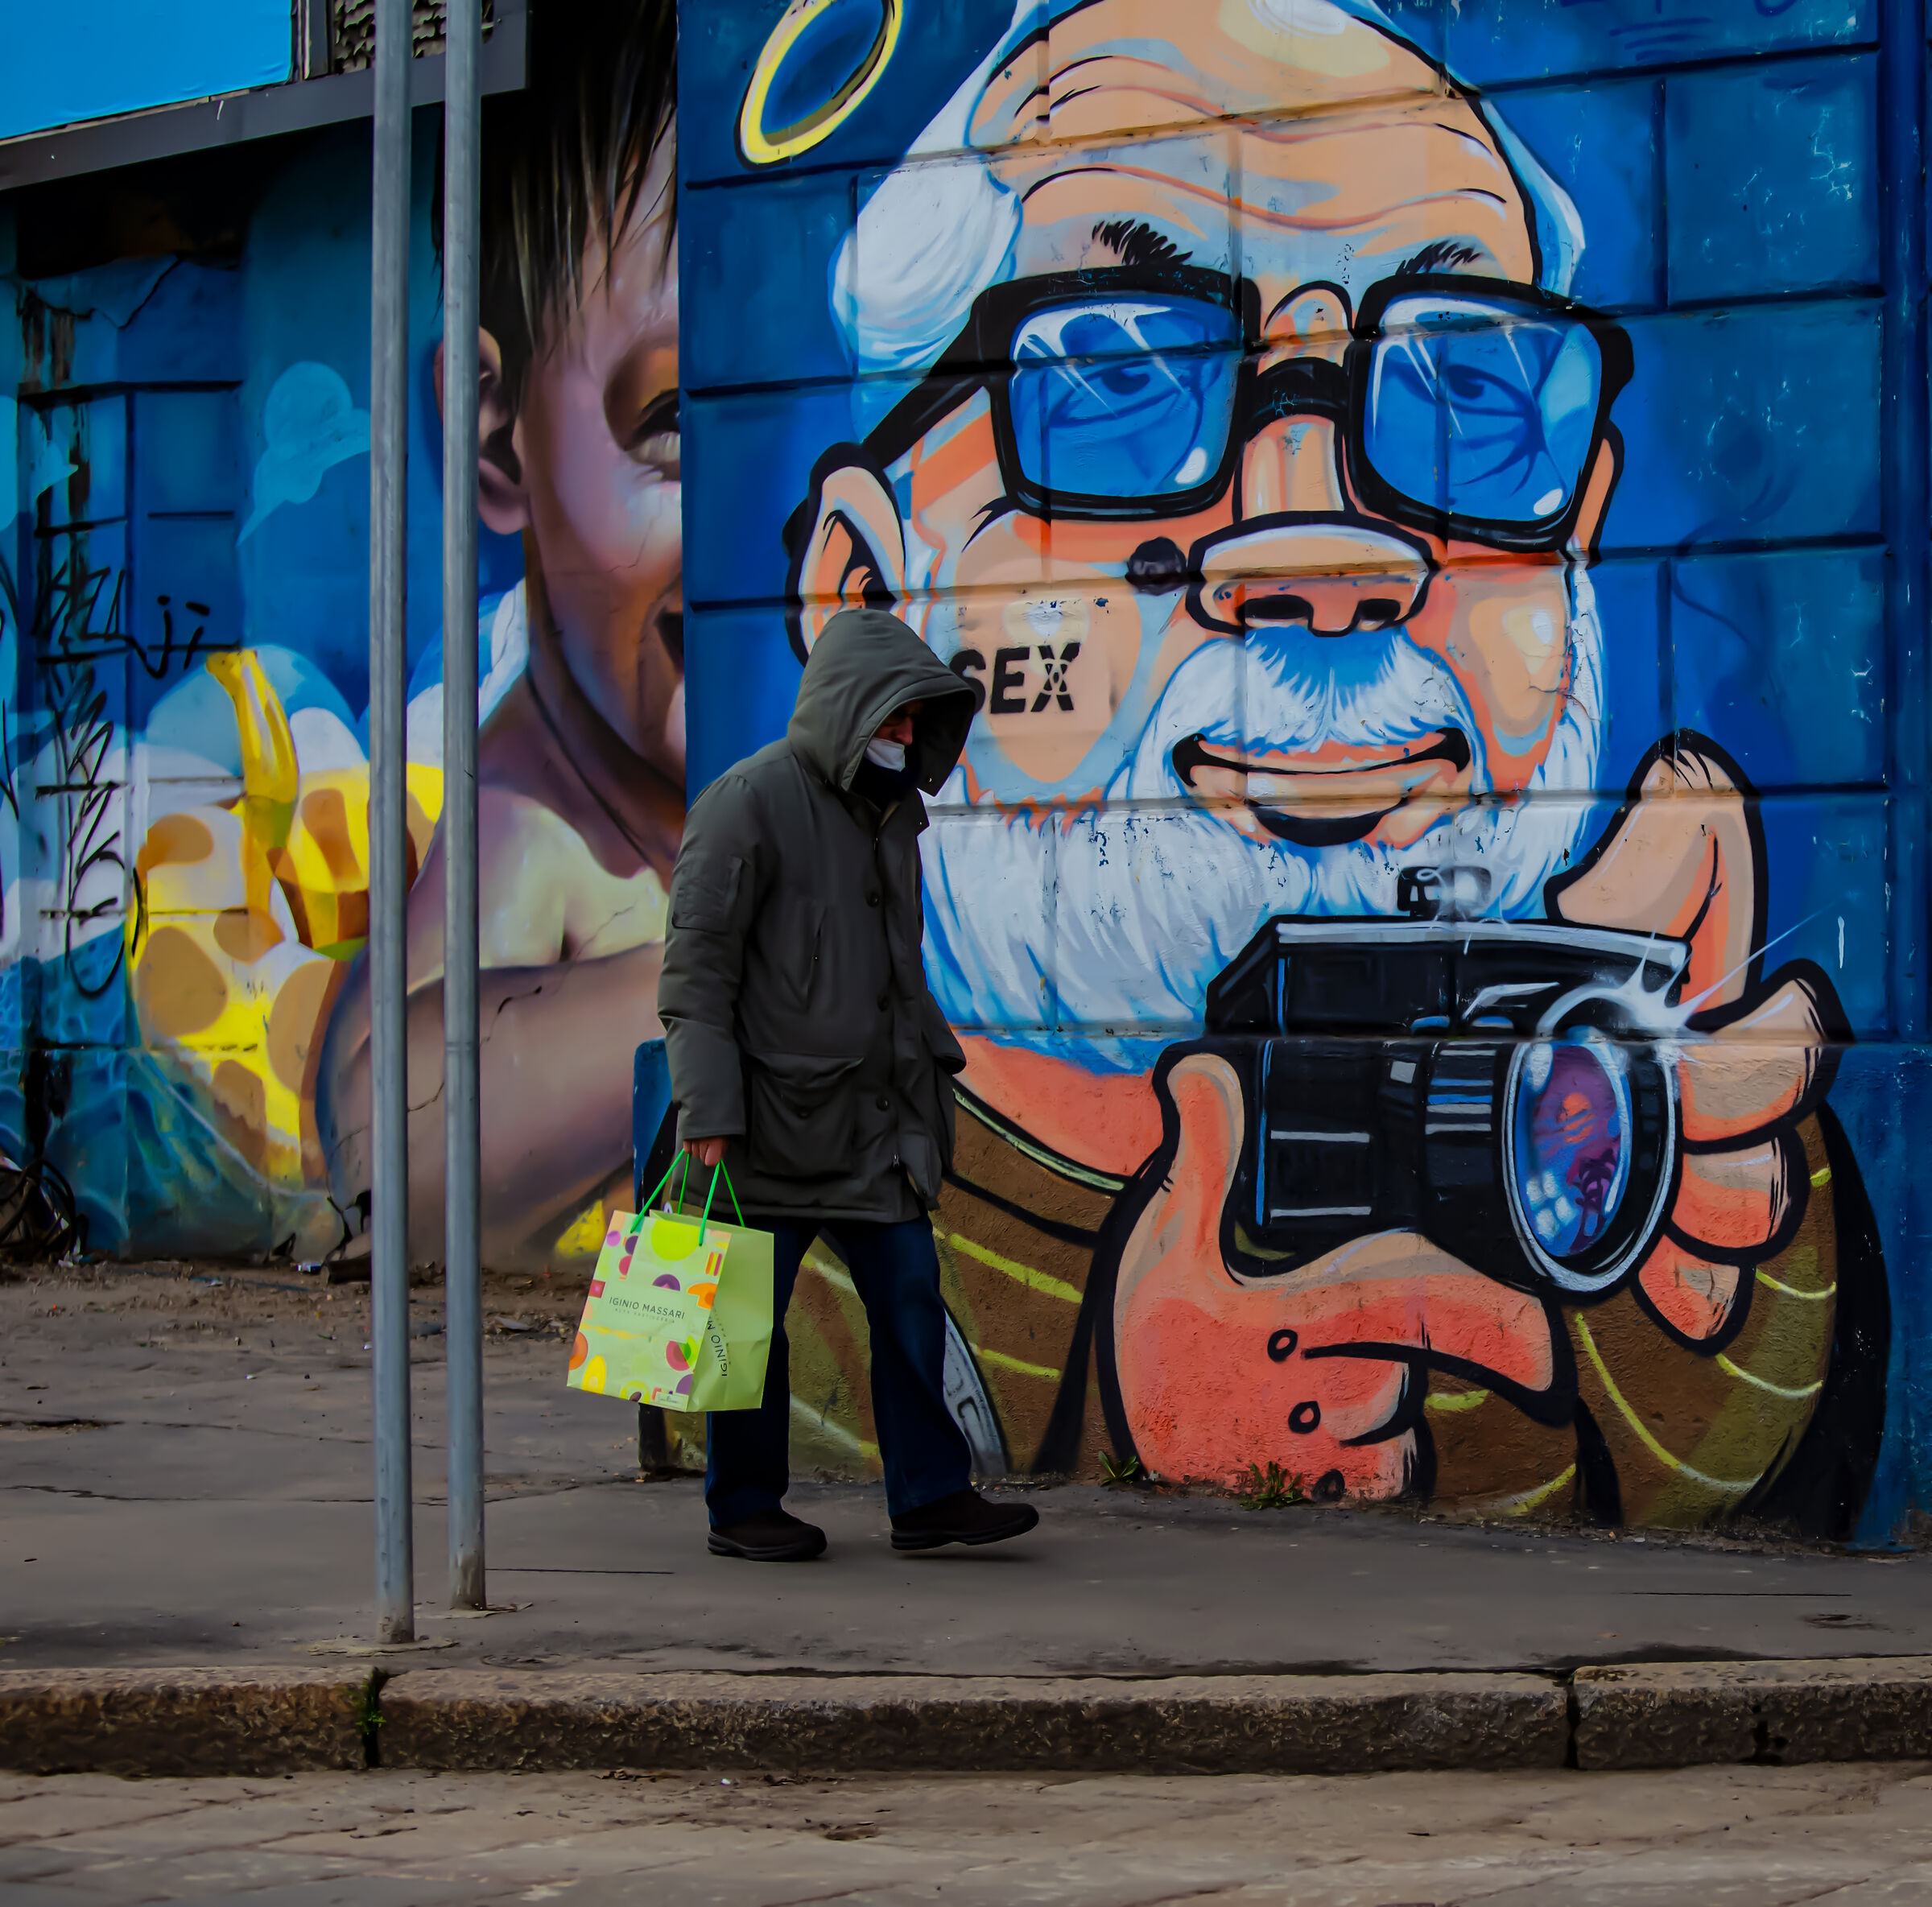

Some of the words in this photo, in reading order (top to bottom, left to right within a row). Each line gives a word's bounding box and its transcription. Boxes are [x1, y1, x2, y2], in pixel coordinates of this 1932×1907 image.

[949, 642, 1081, 715] SEX
[609, 1297, 640, 1311] IGINIO
[642, 1303, 685, 1320] MASSARI
[711, 1334, 728, 1377] IGINIO
